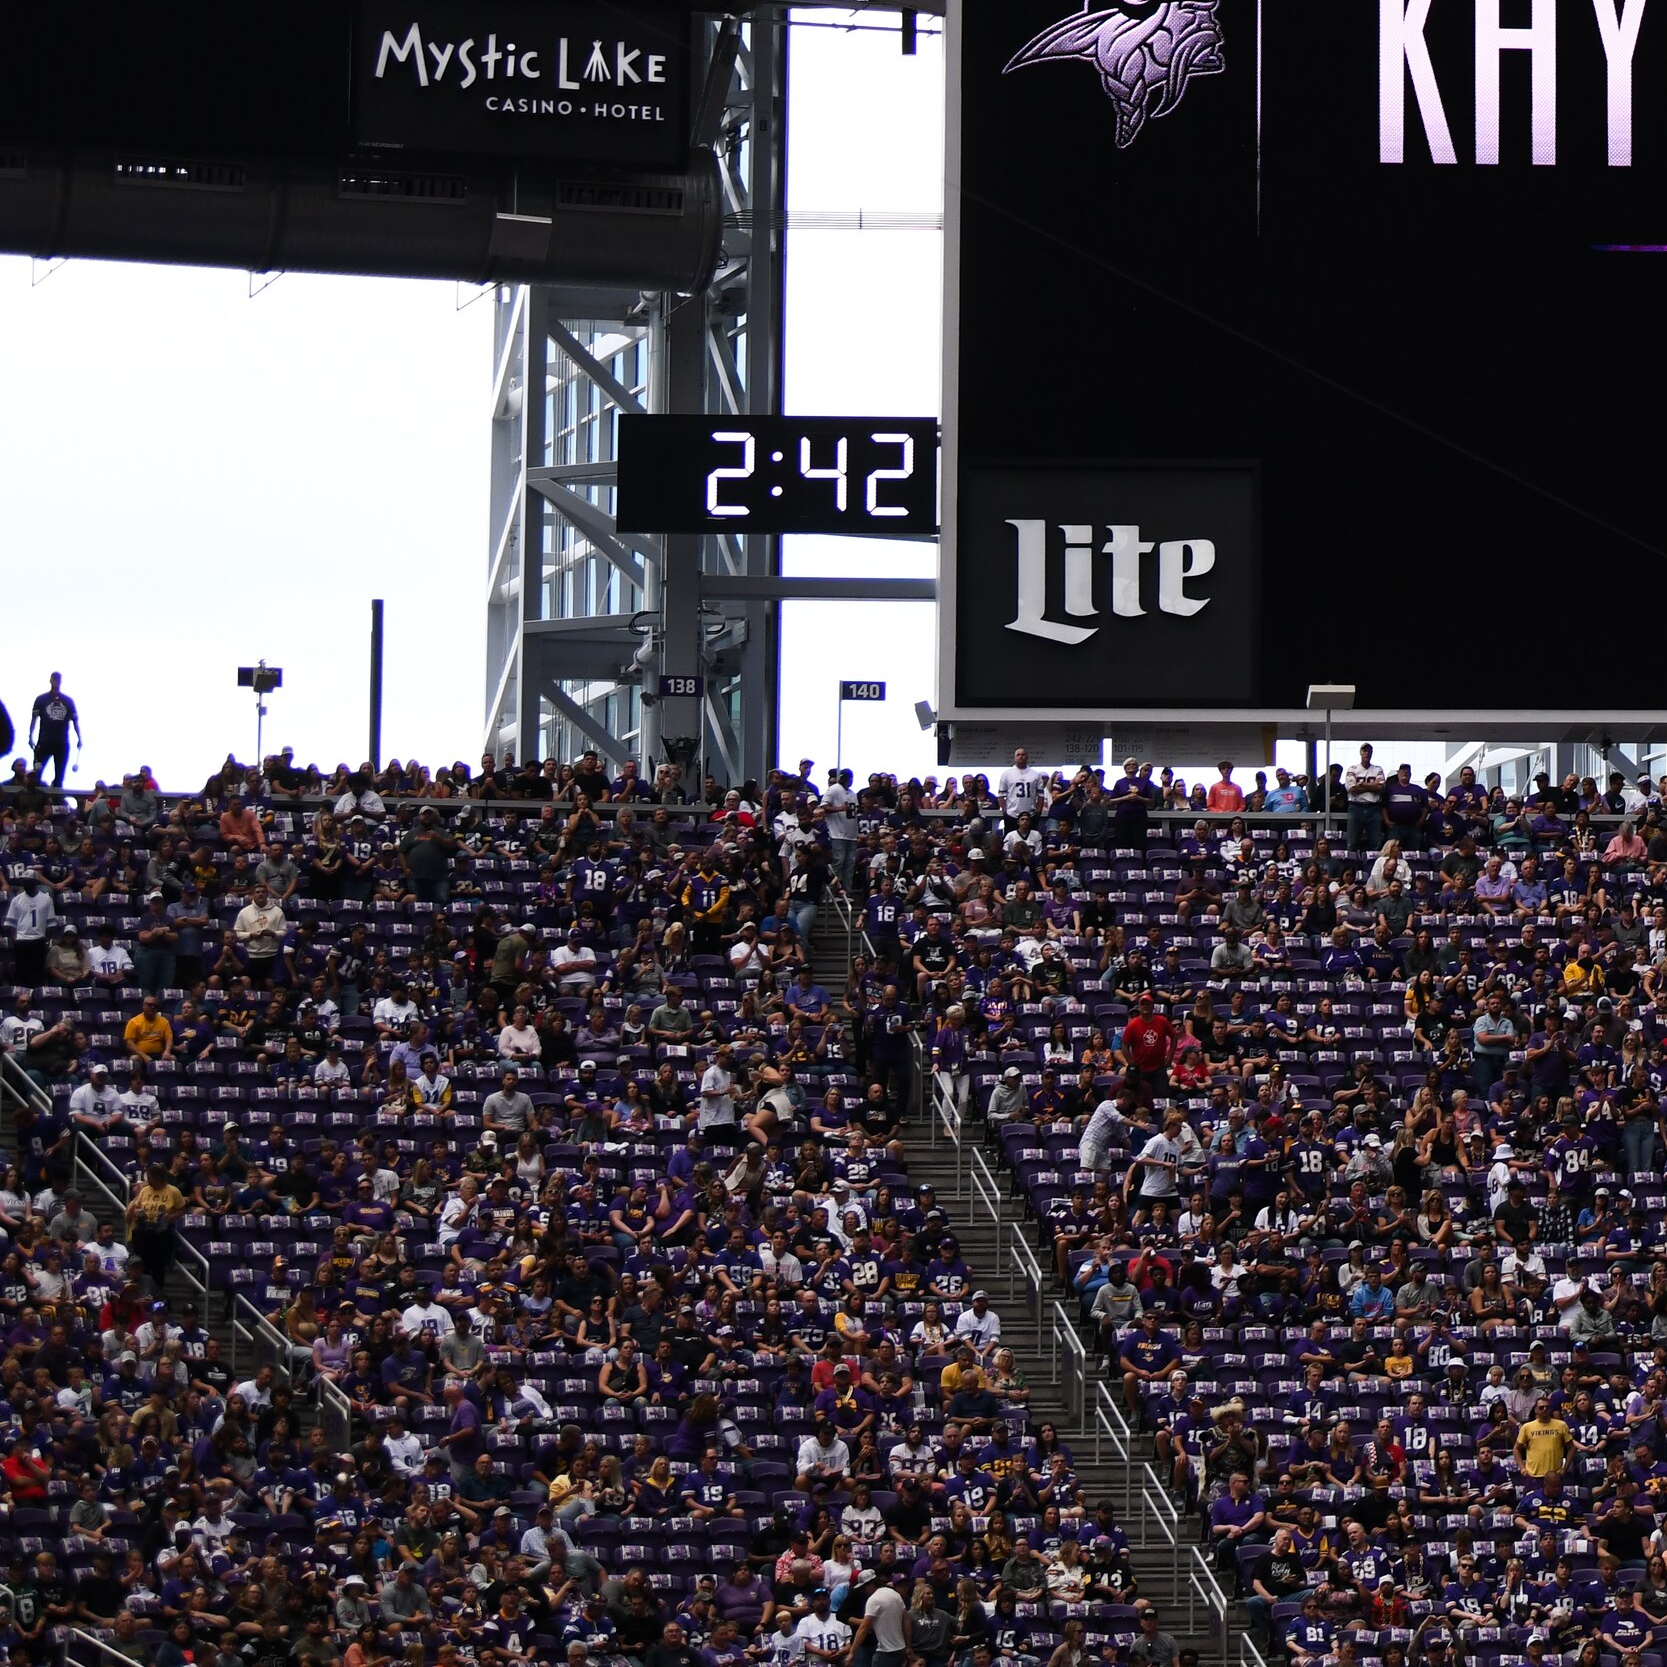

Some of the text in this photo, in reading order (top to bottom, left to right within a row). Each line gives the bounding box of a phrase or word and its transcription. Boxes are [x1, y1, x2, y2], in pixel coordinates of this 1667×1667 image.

[486, 97, 665, 121] CASINO HOTEL
[705, 431, 915, 516] 2:42
[1004, 518, 1216, 646] Lite
[667, 679, 696, 694] 138
[849, 683, 881, 699] 140
[1016, 782, 1030, 796] 31
[352, 843, 371, 857] 19
[584, 870, 606, 890] 18
[700, 890, 716, 906] 11
[1563, 890, 1578, 906] 18
[876, 906, 894, 922] 18
[1299, 1152, 1322, 1173] 18
[1565, 1149, 1589, 1172] 84
[853, 1262, 878, 1283] 28
[4, 1286, 27, 1300] 22
[1428, 1346, 1449, 1365] 80
[1304, 1402, 1322, 1420] 14
[1404, 1426, 1426, 1449] 18
[1578, 1425, 1597, 1443] 14
[1307, 1627, 1323, 1641] 81
